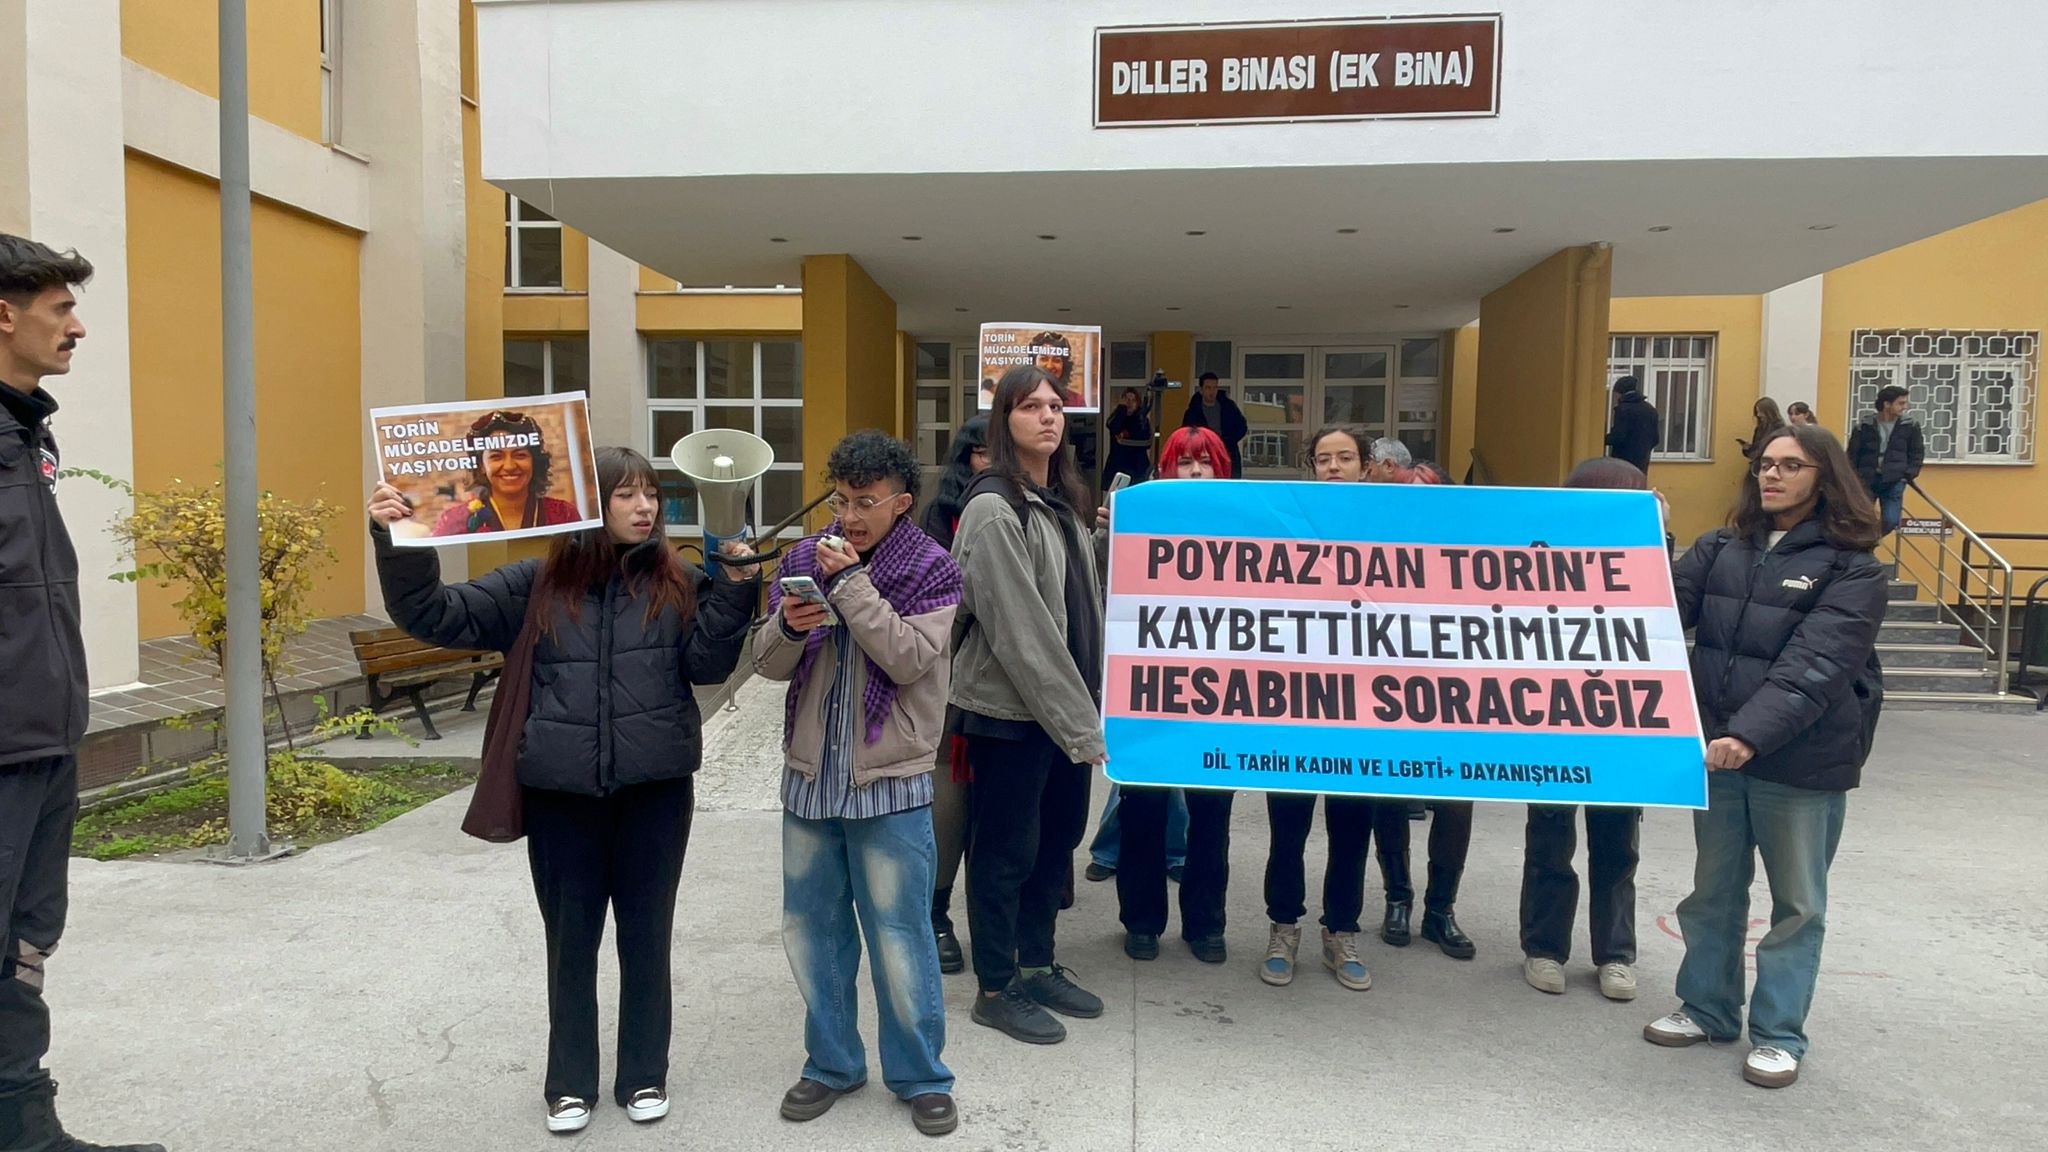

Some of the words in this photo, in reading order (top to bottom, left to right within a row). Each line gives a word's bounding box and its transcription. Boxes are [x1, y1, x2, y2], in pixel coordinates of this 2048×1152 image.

[1329, 50, 1381, 92] (EK
[384, 432, 541, 459] MÜCADELEMİZDE
[388, 456, 478, 477] YAŞIYOR!
[1137, 599, 1651, 662] KAYBETTİKLERİMİZİN
[1129, 665, 1357, 721] HESABINI
[1371, 668, 1670, 729] SORACAĞIZ
[1203, 747, 1231, 770] DİL
[1236, 750, 1287, 772] TARİH
[1295, 755, 1353, 775] KADIN
[1359, 758, 1383, 776] VE
[1388, 756, 1455, 779] LGBTİ+
[1460, 762, 1592, 787] DAYANIŞMASI
